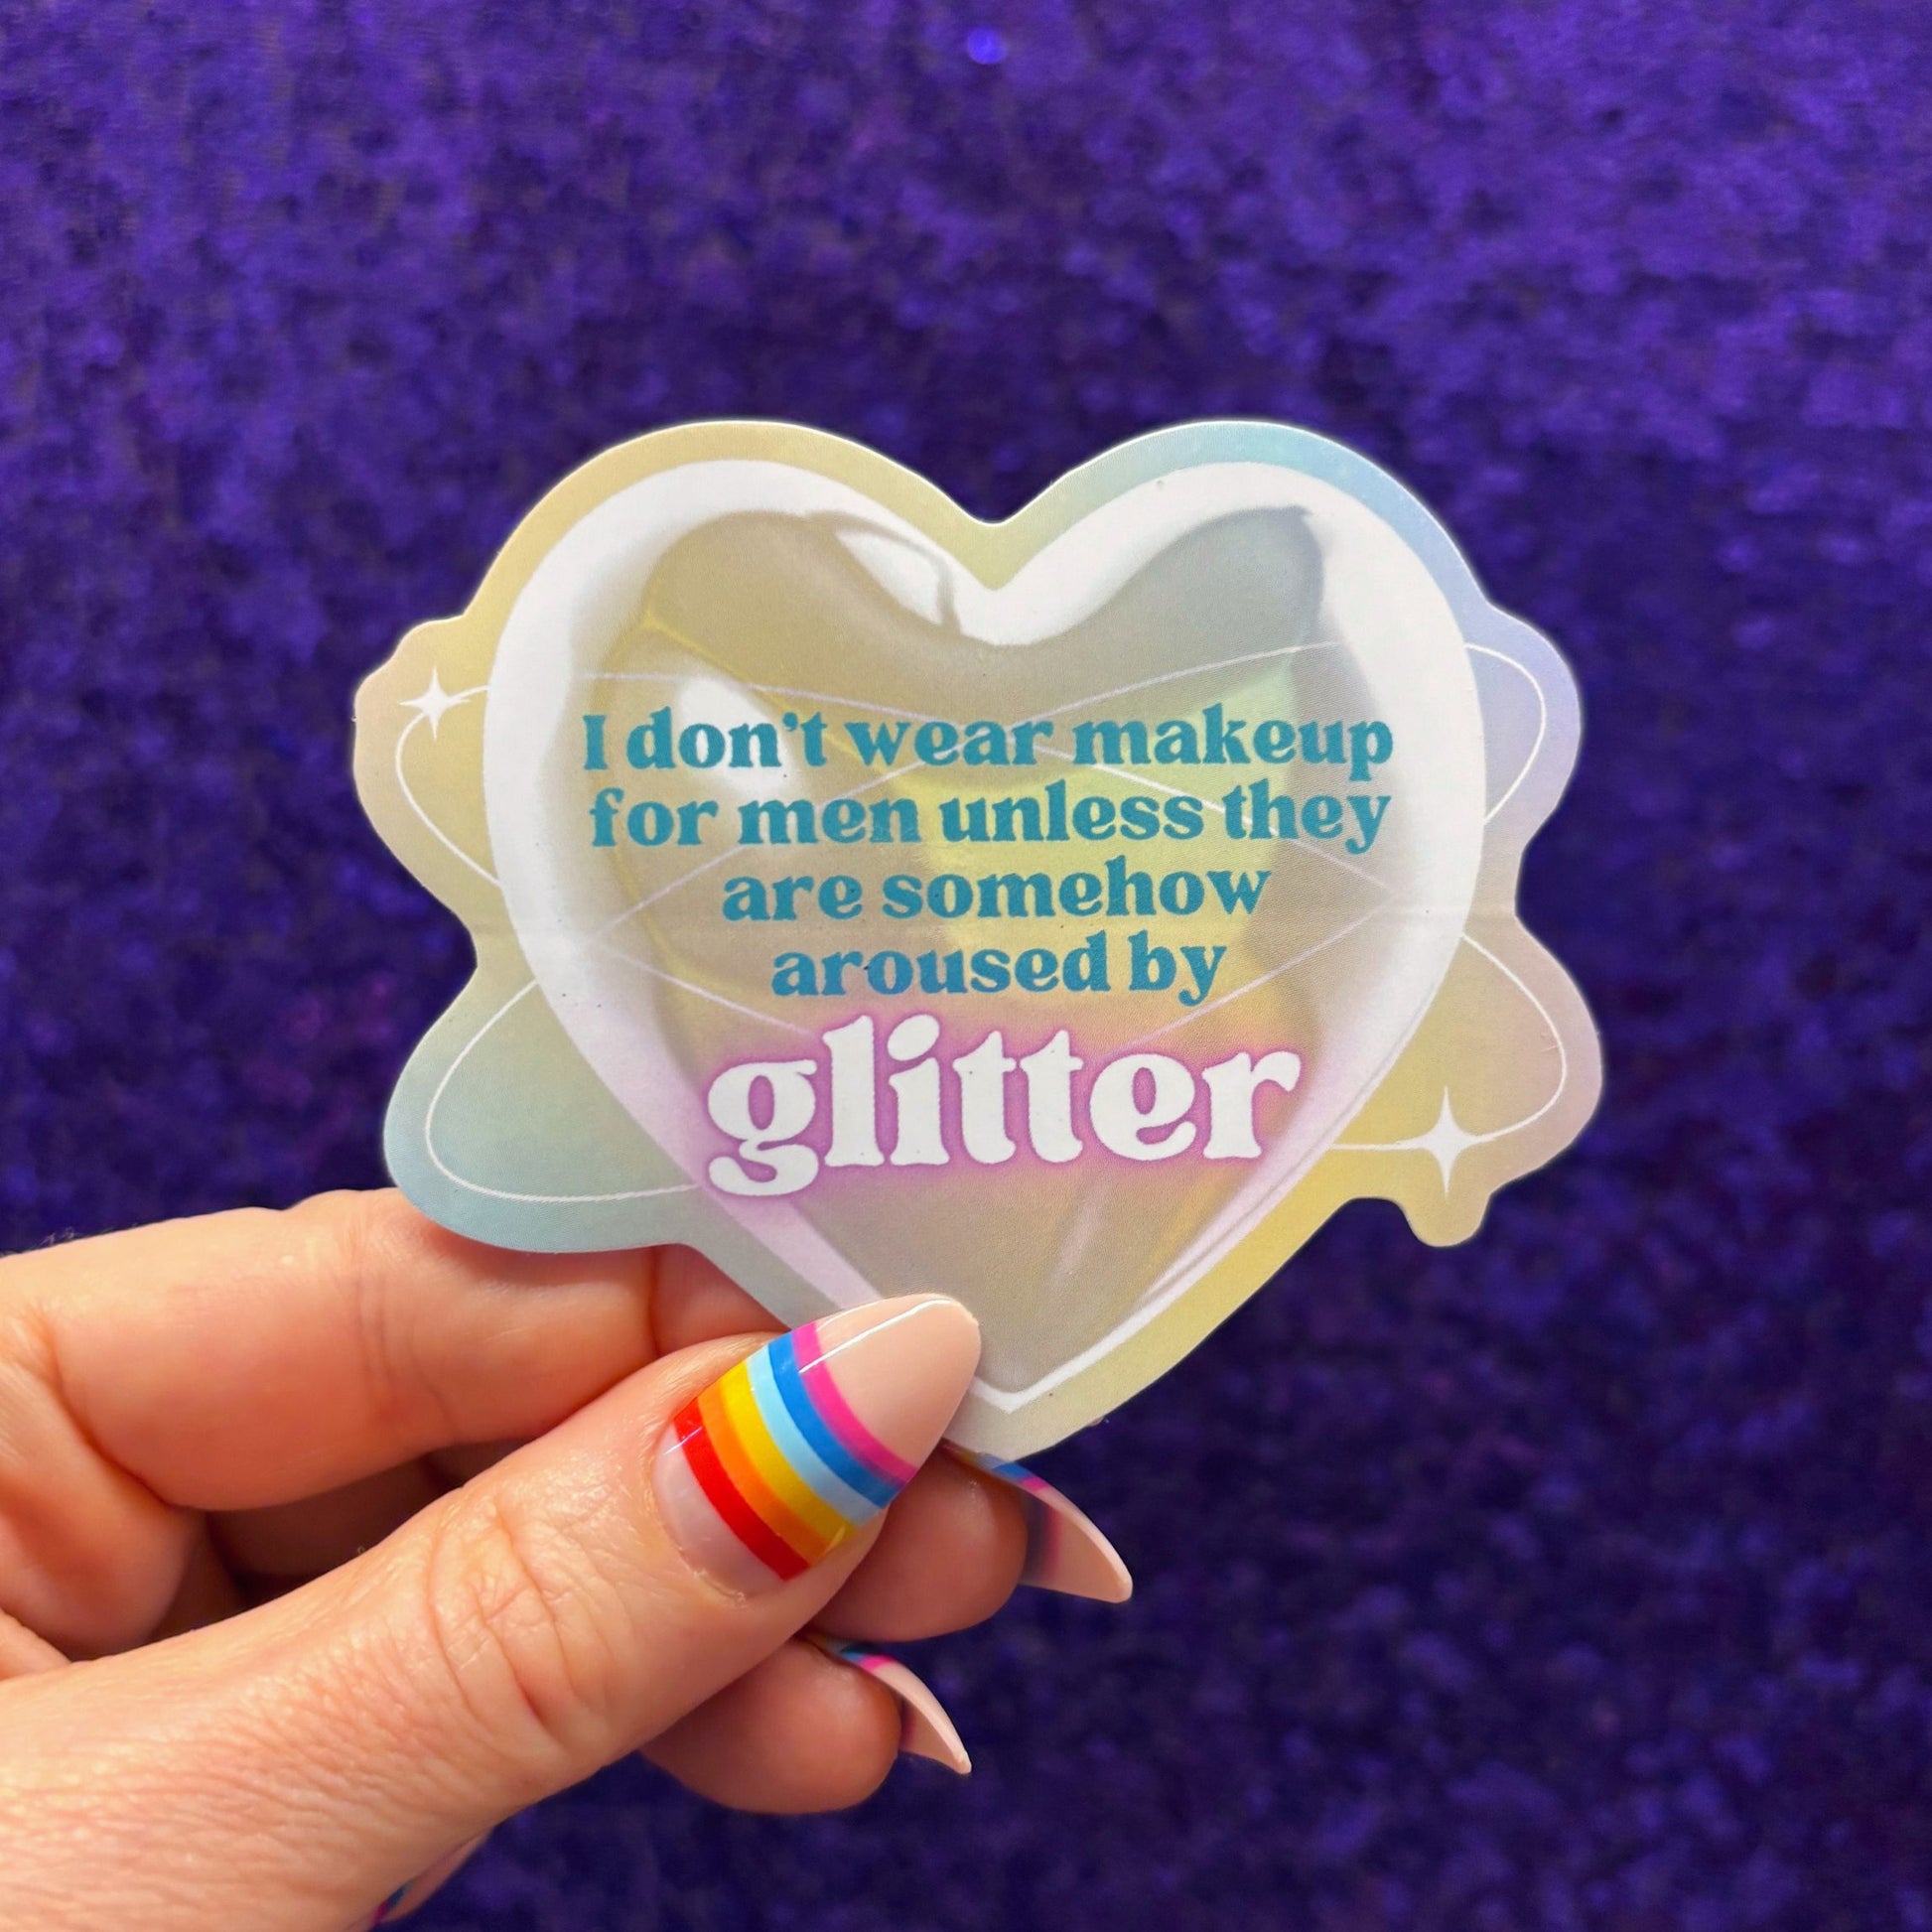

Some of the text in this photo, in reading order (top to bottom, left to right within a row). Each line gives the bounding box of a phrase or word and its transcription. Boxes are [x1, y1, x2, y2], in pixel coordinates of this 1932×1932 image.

[582, 703, 1394, 782] I don't wear makeup
[590, 777, 1392, 856] for men unless they
[722, 855, 1271, 921] are somehow
[770, 929, 1227, 1007] aroused by
[706, 1014, 1303, 1197] glitter
